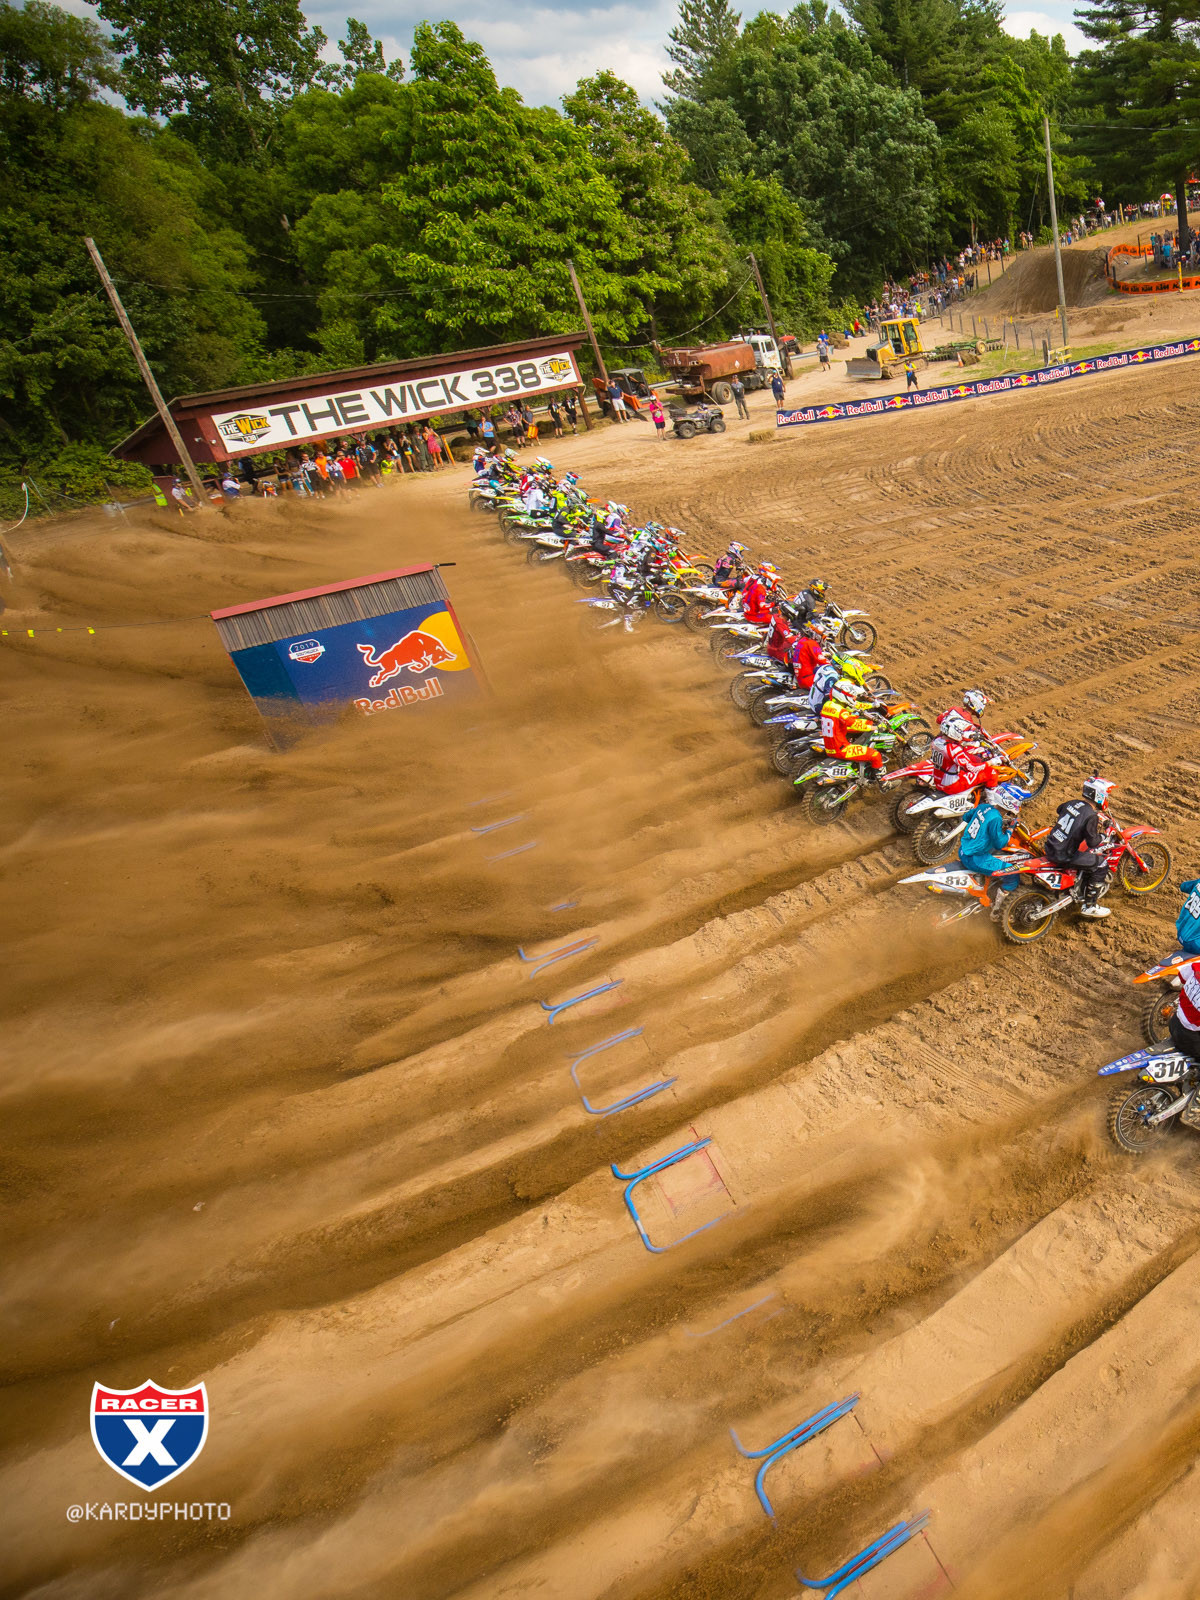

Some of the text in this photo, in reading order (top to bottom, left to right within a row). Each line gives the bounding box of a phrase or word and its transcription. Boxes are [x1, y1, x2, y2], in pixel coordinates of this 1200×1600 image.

[269, 362, 541, 436] THE WICK 338
[219, 416, 270, 437] THE WICK
[295, 641, 315, 651] 2019
[832, 767, 847, 776] 88
[949, 798, 965, 809] 880
[1058, 813, 1075, 835] 41
[945, 875, 969, 886] 813
[1045, 873, 1061, 884] 41
[1154, 1059, 1186, 1079] 314
